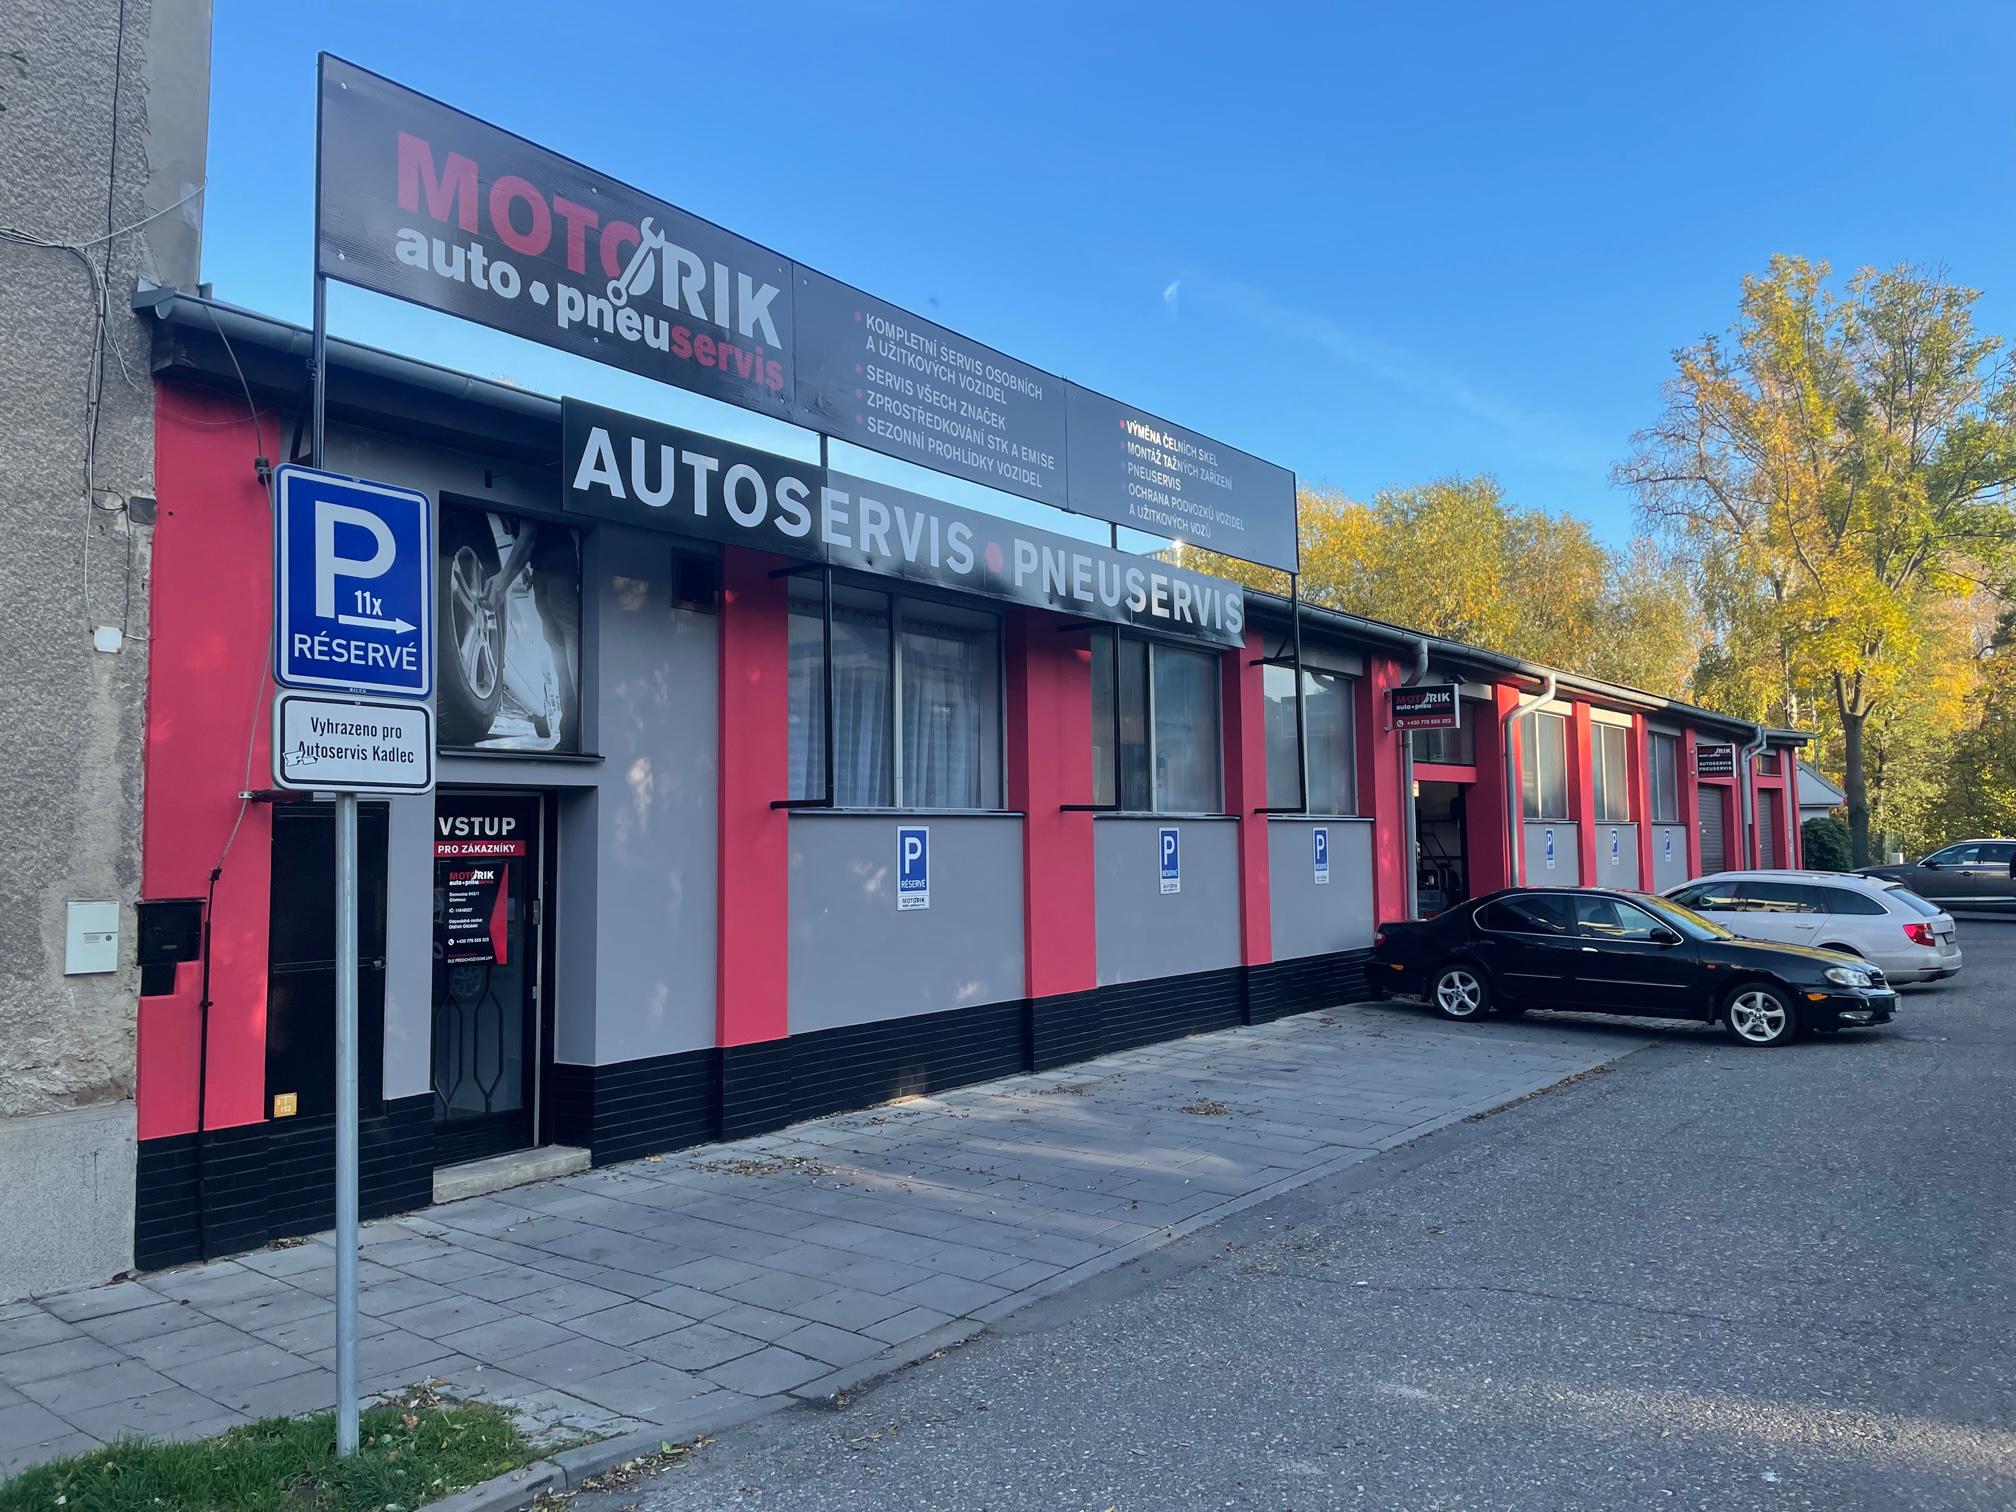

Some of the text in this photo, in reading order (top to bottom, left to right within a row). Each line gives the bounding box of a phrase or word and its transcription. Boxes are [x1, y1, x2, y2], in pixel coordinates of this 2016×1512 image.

[395, 228, 521, 299] auto
[397, 131, 782, 349] MOTORIK
[866, 313, 1043, 400] KOMPLETNÍ SERVIS OSOBNÍCH
[866, 335, 1007, 405] A UŽITKOVÝCH VOZIDEL
[867, 365, 1006, 431] SERVIS VŠECH ZNAČEK
[867, 390, 1055, 470] ZPROSTŘEDKOVÁNÍ STK A EMISE
[867, 416, 1043, 488] SEZONNÍ PROHLÍDKY VOZIDEL
[1126, 420, 1218, 467] VÝMĚNA ČELNÍCH SKEL
[1127, 441, 1233, 490] MONTÁŽ TAŽNÝCH ZAŘÍZENÍ
[1128, 462, 1182, 491] PNEUSERVIS
[573, 426, 1244, 634] AUTOSERVIS PNEUSERVIS
[1128, 483, 1245, 531] OCHRANA PODVOZKŮ VOZIDEL
[1129, 503, 1212, 538] A UŽITKOVÝCH VOZŮ
[315, 500, 396, 619] P
[354, 590, 383, 616] 11x
[294, 630, 418, 671] RÉSERVÉ
[298, 740, 415, 764] Autoservis Kadlec
[310, 716, 402, 741] Vyhrazeno pro
[437, 842, 516, 854] PRO ZÁKAZNÍKY
[438, 816, 516, 836] VSTUP
[1316, 834, 1325, 860] P
[904, 836, 922, 874] P
[1163, 835, 1175, 866] P
